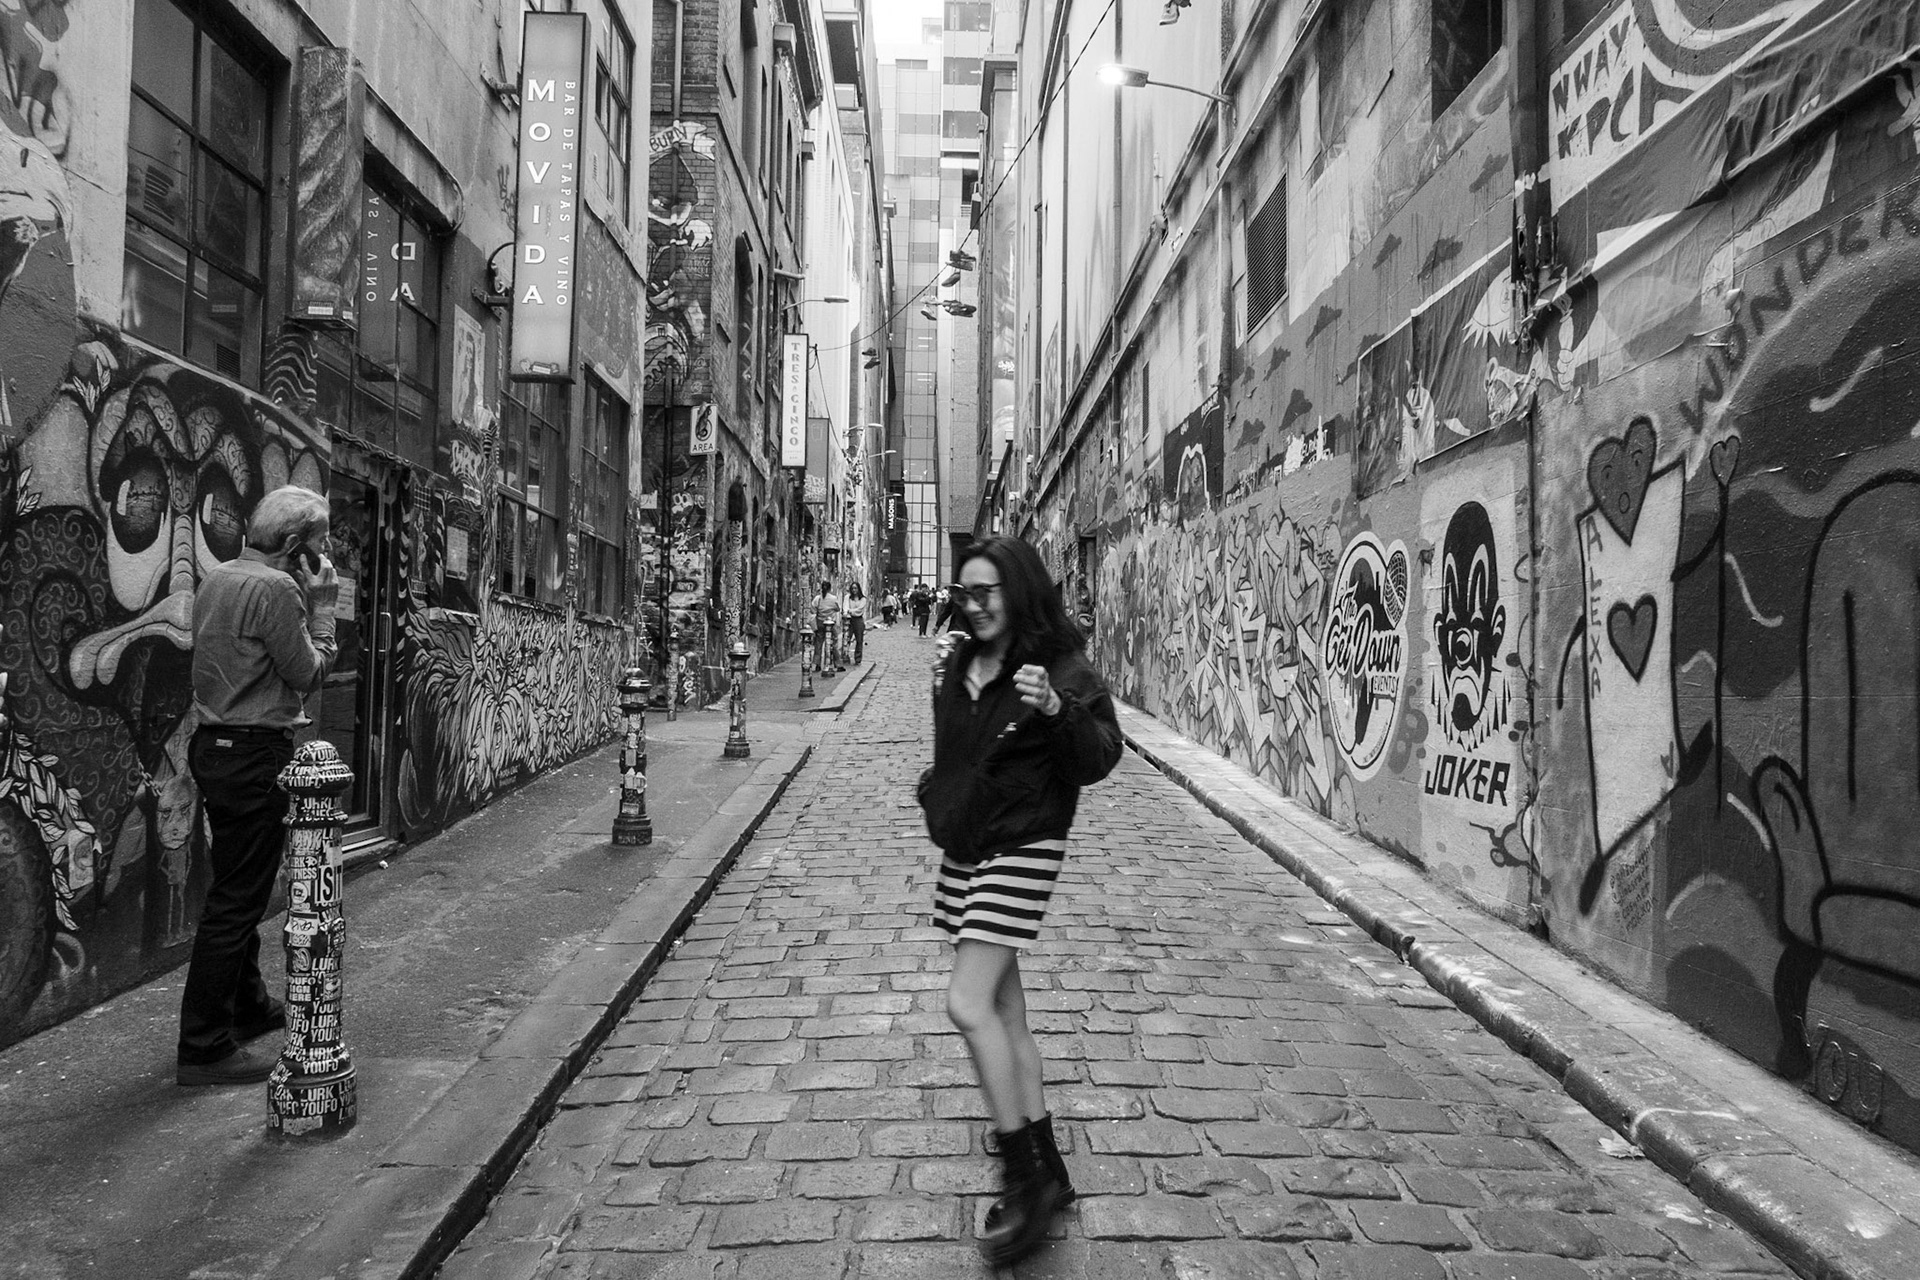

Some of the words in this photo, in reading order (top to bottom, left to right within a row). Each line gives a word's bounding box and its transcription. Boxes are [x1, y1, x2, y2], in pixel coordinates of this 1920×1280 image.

[563, 81, 576, 116] BAR
[562, 128, 574, 151] DE
[521, 79, 556, 305] MOVIDA
[559, 162, 573, 222] TAPAS
[558, 234, 570, 243] Y
[556, 255, 569, 306] VINO
[790, 342, 800, 384] TRES
[788, 394, 800, 447] CINCO
[692, 443, 714, 452] AREA
[1586, 515, 1603, 700] ALEXA
[1351, 604, 1401, 678] Down
[1373, 674, 1396, 694] EVENTS
[1424, 754, 1511, 807] JOKER
[300, 1098, 339, 1116] YOUFO
